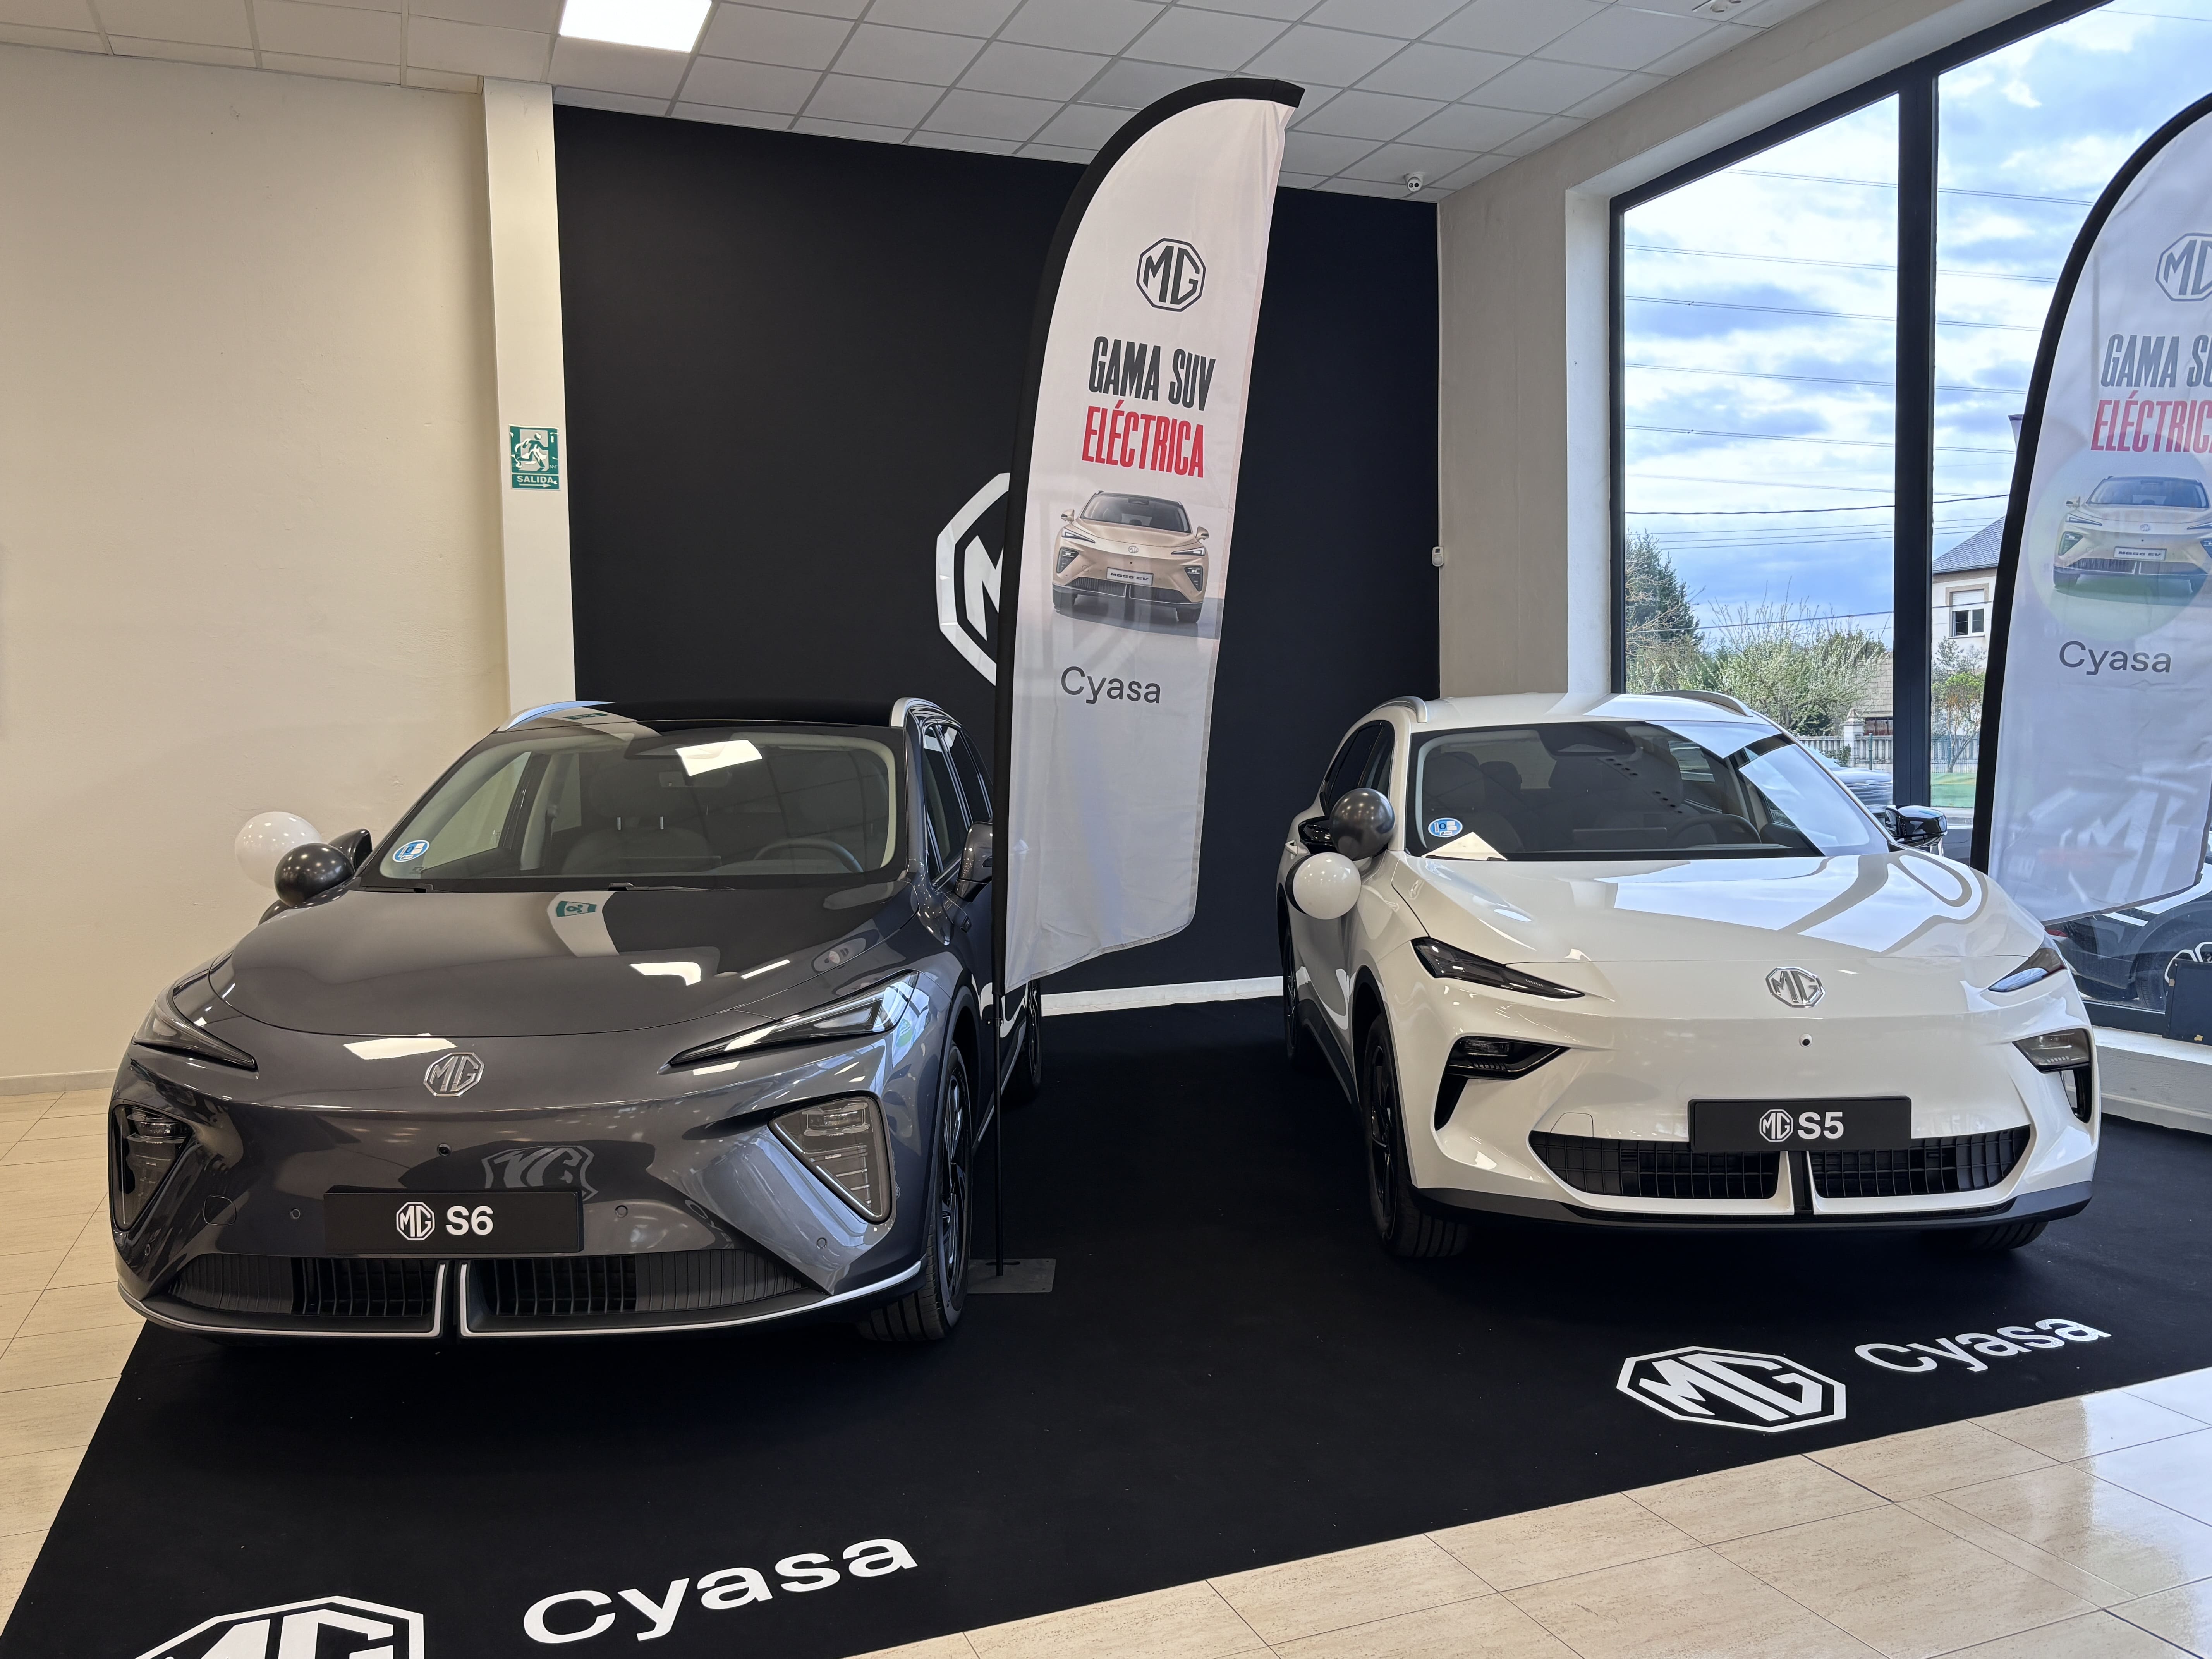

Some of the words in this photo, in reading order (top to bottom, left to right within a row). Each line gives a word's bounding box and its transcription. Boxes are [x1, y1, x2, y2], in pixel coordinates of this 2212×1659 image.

[1144, 245, 1200, 305] MG
[1088, 336, 1161, 401] GAMA
[1169, 349, 1216, 411] SUV
[2100, 334, 2179, 387] GAMA
[1082, 399, 1204, 478] ELÉCTRICA
[2091, 390, 2212, 453] ELÉCTRIC
[517, 475, 553, 484] SALIDA
[2059, 641, 2171, 675] Cyasa
[1061, 666, 1161, 704] Cyasa
[1771, 970, 1819, 1004] MG
[429, 1056, 479, 1092] MG
[1763, 1112, 1791, 1140] MG
[1798, 1111, 1844, 1139] S5
[400, 1205, 432, 1238] MG
[446, 1206, 494, 1235] S6
[1855, 1318, 2112, 1373] Cyasa
[1639, 1353, 1822, 1421] MG
[522, 1537, 919, 1644] Cyasa
